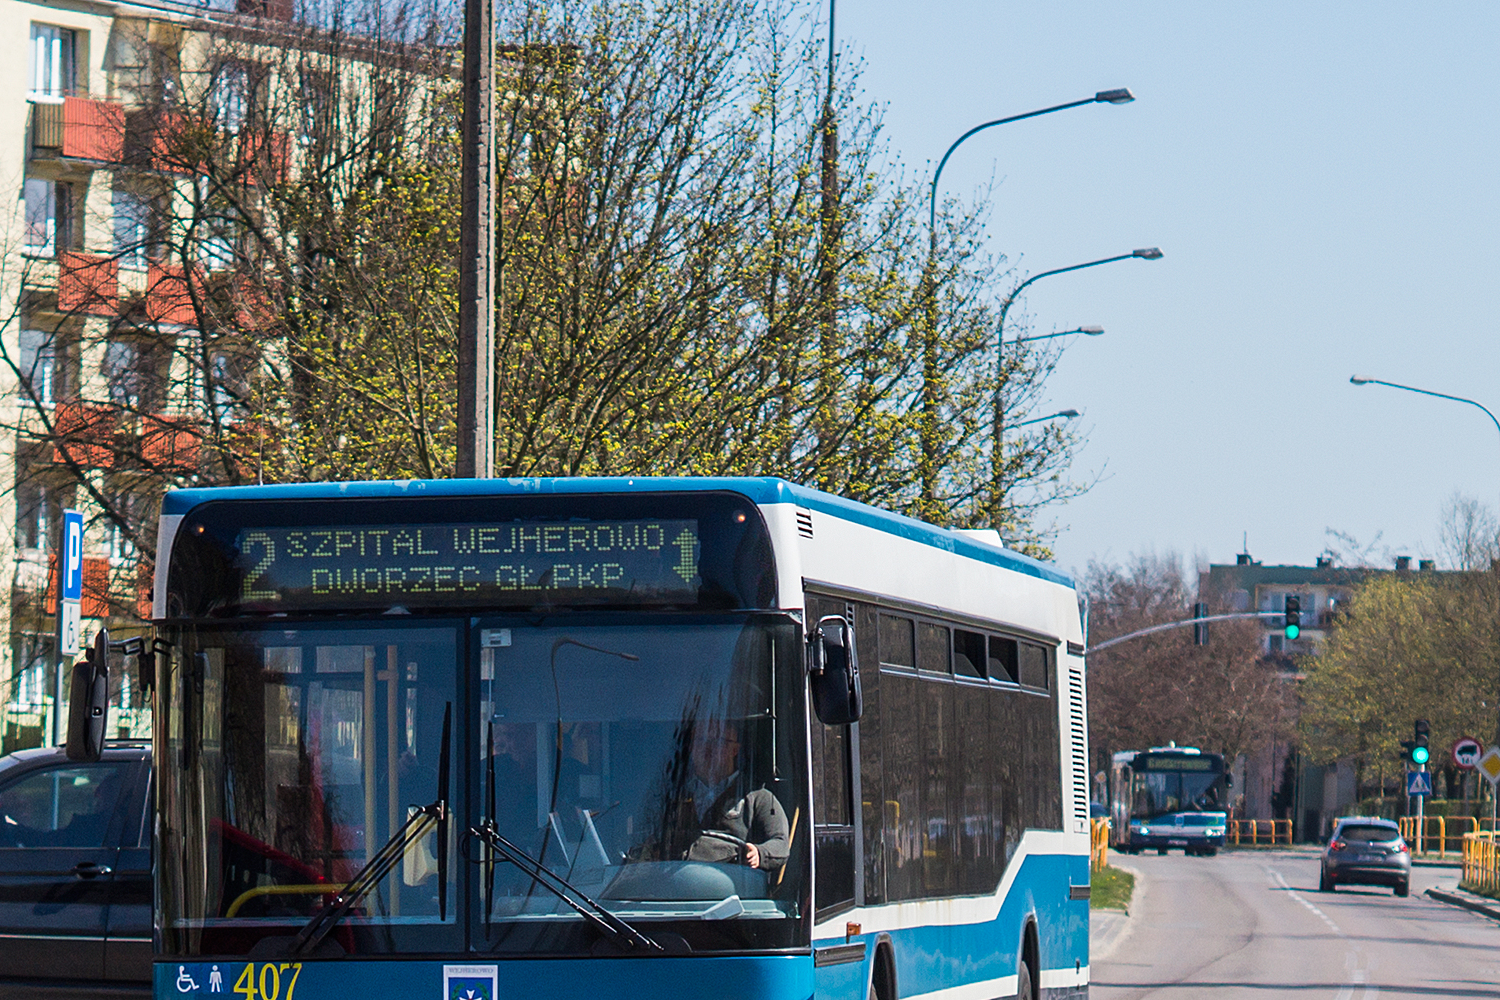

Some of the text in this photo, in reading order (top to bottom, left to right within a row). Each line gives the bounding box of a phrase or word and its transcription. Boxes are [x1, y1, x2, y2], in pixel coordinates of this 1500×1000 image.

[68, 522, 80, 589] P
[241, 532, 278, 599] 2
[287, 524, 664, 557] SZPITAL WEJHEROWO
[312, 565, 481, 594] DWORZEC
